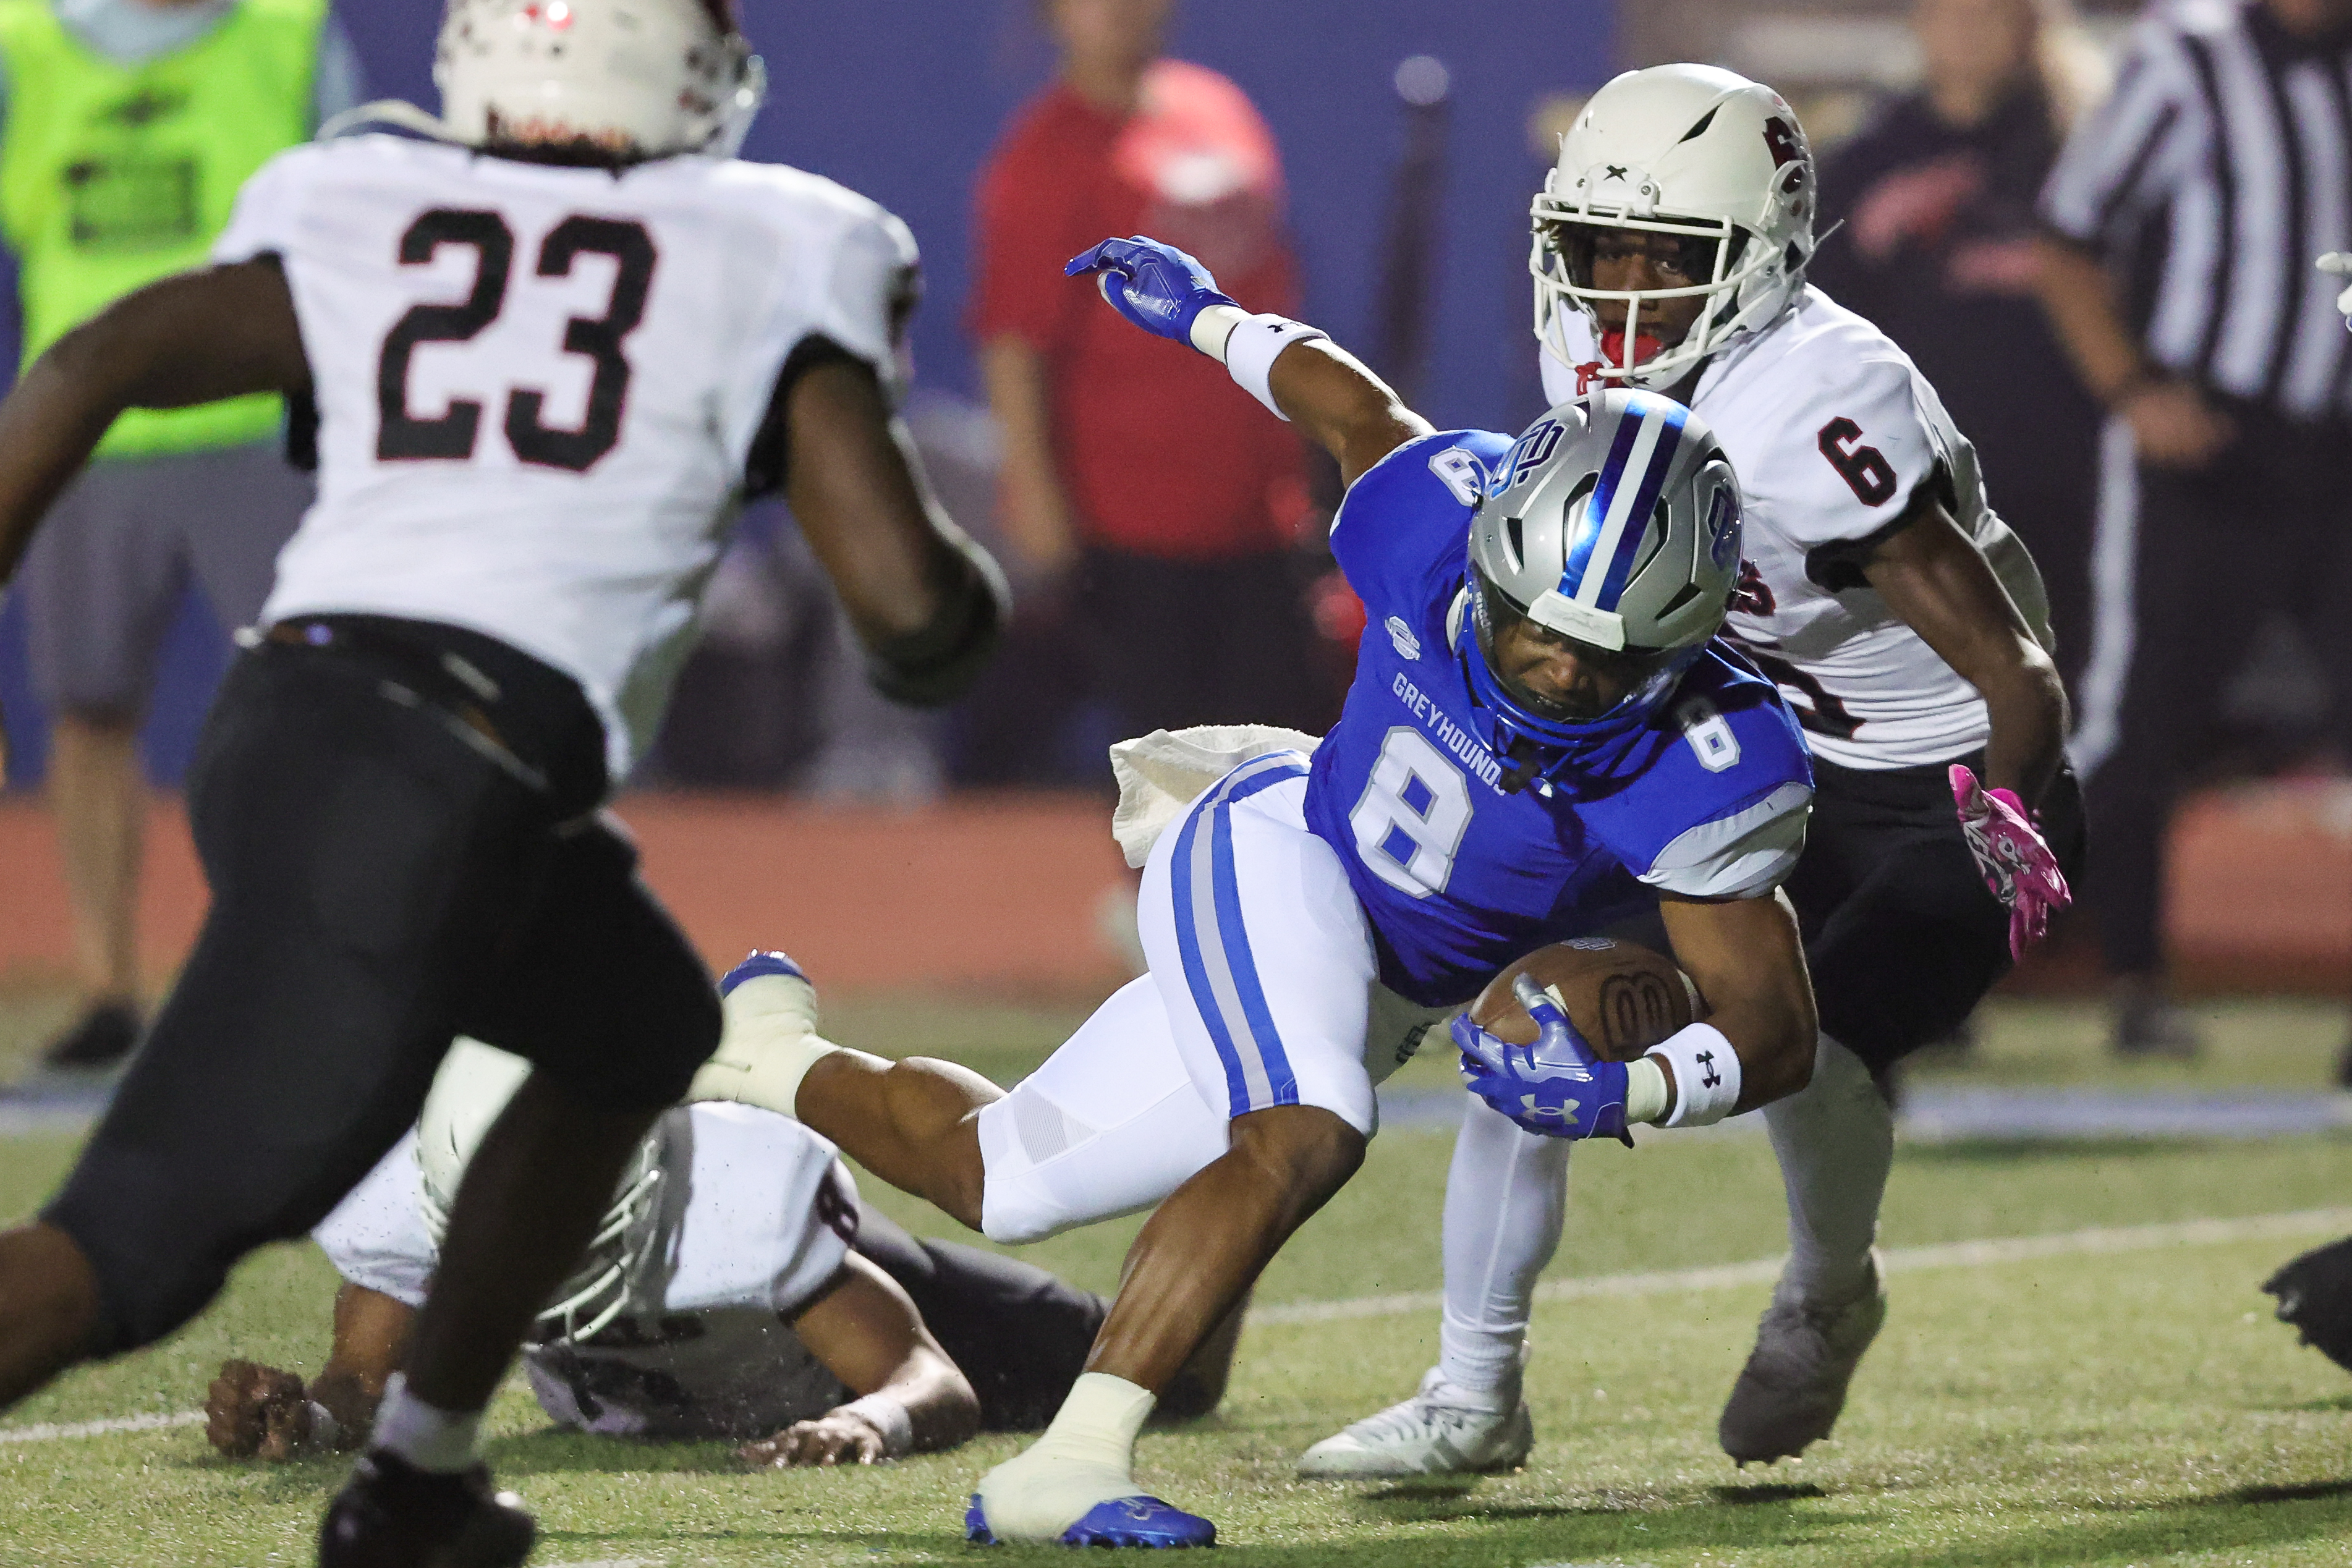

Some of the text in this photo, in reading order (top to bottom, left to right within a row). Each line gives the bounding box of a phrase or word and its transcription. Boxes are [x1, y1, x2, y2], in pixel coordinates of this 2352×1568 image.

[376, 209, 658, 472] 23
[1427, 445, 1492, 507] 8
[1817, 416, 1896, 508] 6
[1348, 726, 1475, 899] 8
